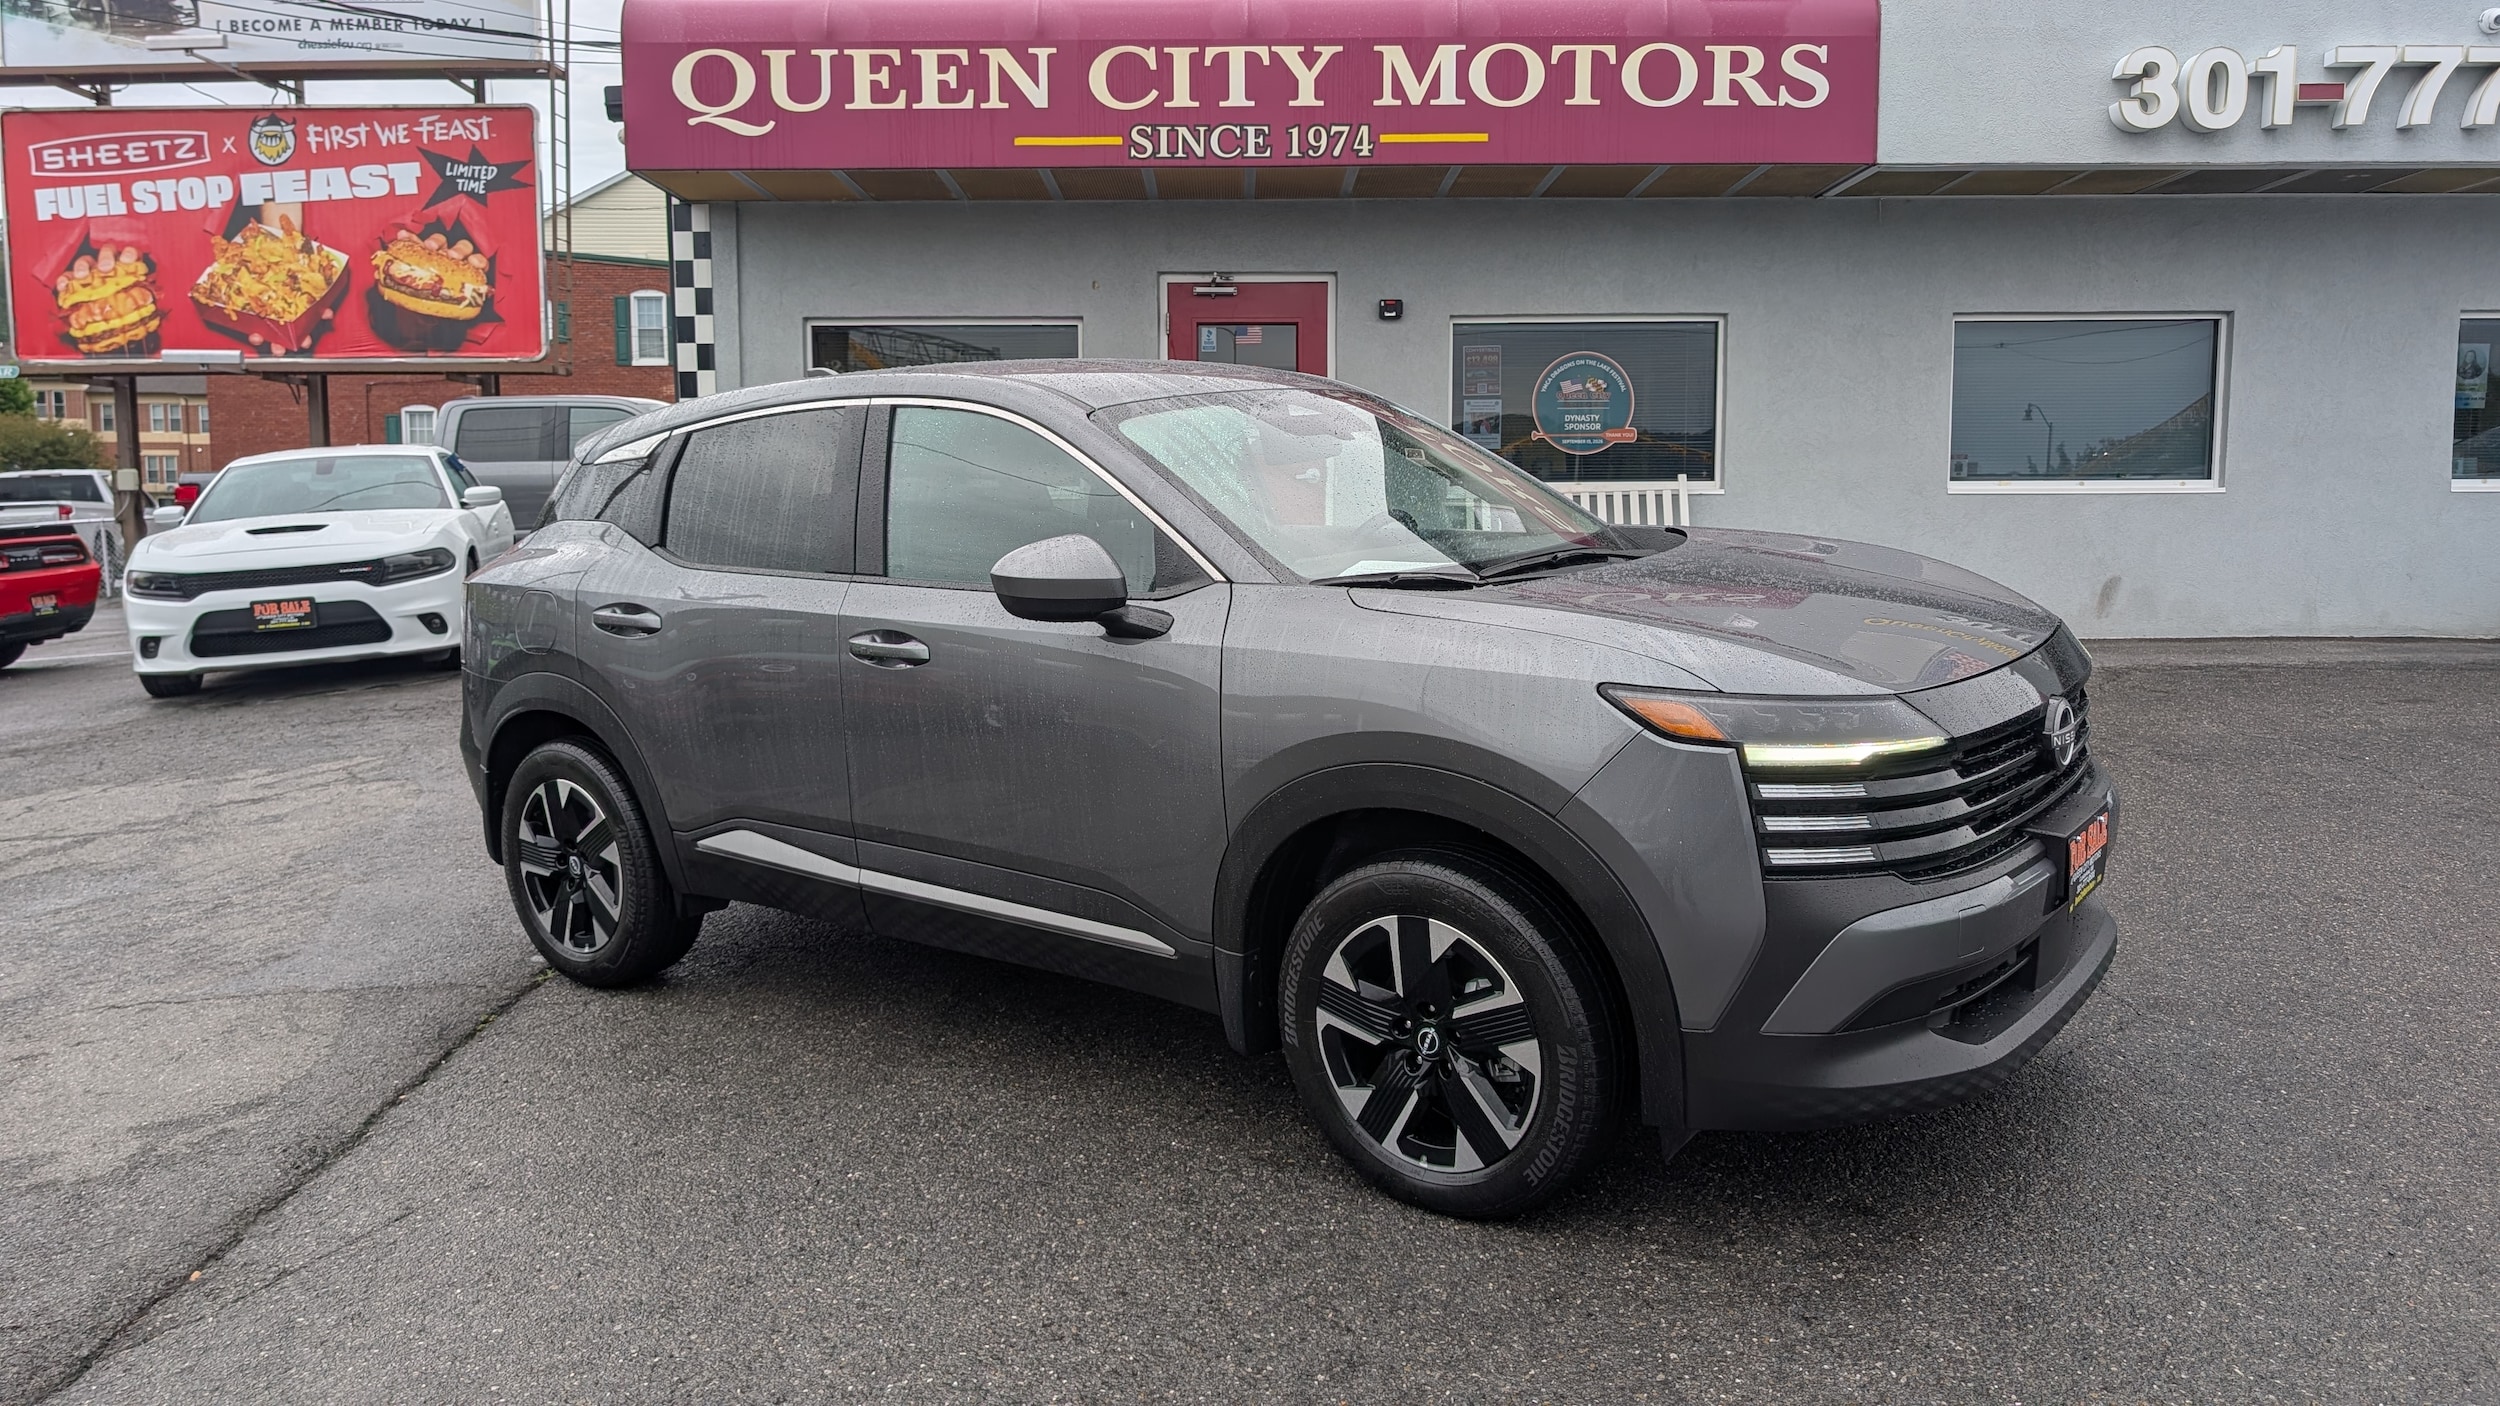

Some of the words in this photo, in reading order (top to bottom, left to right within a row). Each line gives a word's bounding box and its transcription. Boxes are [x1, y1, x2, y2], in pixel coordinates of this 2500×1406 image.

[229, 18, 302, 33] BECOME
[309, 18, 322, 32] A
[329, 18, 404, 32] MEMBER
[414, 18, 472, 32] TODAY
[670, 47, 1058, 137] QUEEN
[1087, 45, 1344, 111] CITY
[1372, 42, 1831, 109] MOTORS
[305, 122, 371, 154] FIRST
[373, 120, 411, 148] WE
[412, 114, 494, 145] FEAST
[1128, 122, 1273, 161] SINCE
[1285, 122, 1375, 159] 1974
[42, 137, 197, 170] SHEETZ
[444, 162, 499, 181] LIMITED
[455, 178, 488, 195] TIME
[34, 182, 129, 222] FUEL
[131, 175, 235, 215] STOP
[238, 161, 423, 207] FEAST
[1540, 377, 1553, 393] YMCA
[1550, 360, 1576, 379] DRAGONS
[1585, 359, 1598, 367] THE
[1596, 361, 1611, 373] LAKE
[1608, 368, 1628, 393] FESTIVAL
[1563, 422, 1602, 431] SPONSOR
[1564, 414, 1600, 422] DYNASTY
[253, 602, 279, 616] FOR
[280, 599, 311, 614] SALE
[2053, 730, 2075, 747] NISS
[1283, 910, 1327, 1048] BRIDGESTONE
[1522, 1043, 1579, 1189] BRIDGESTONE
